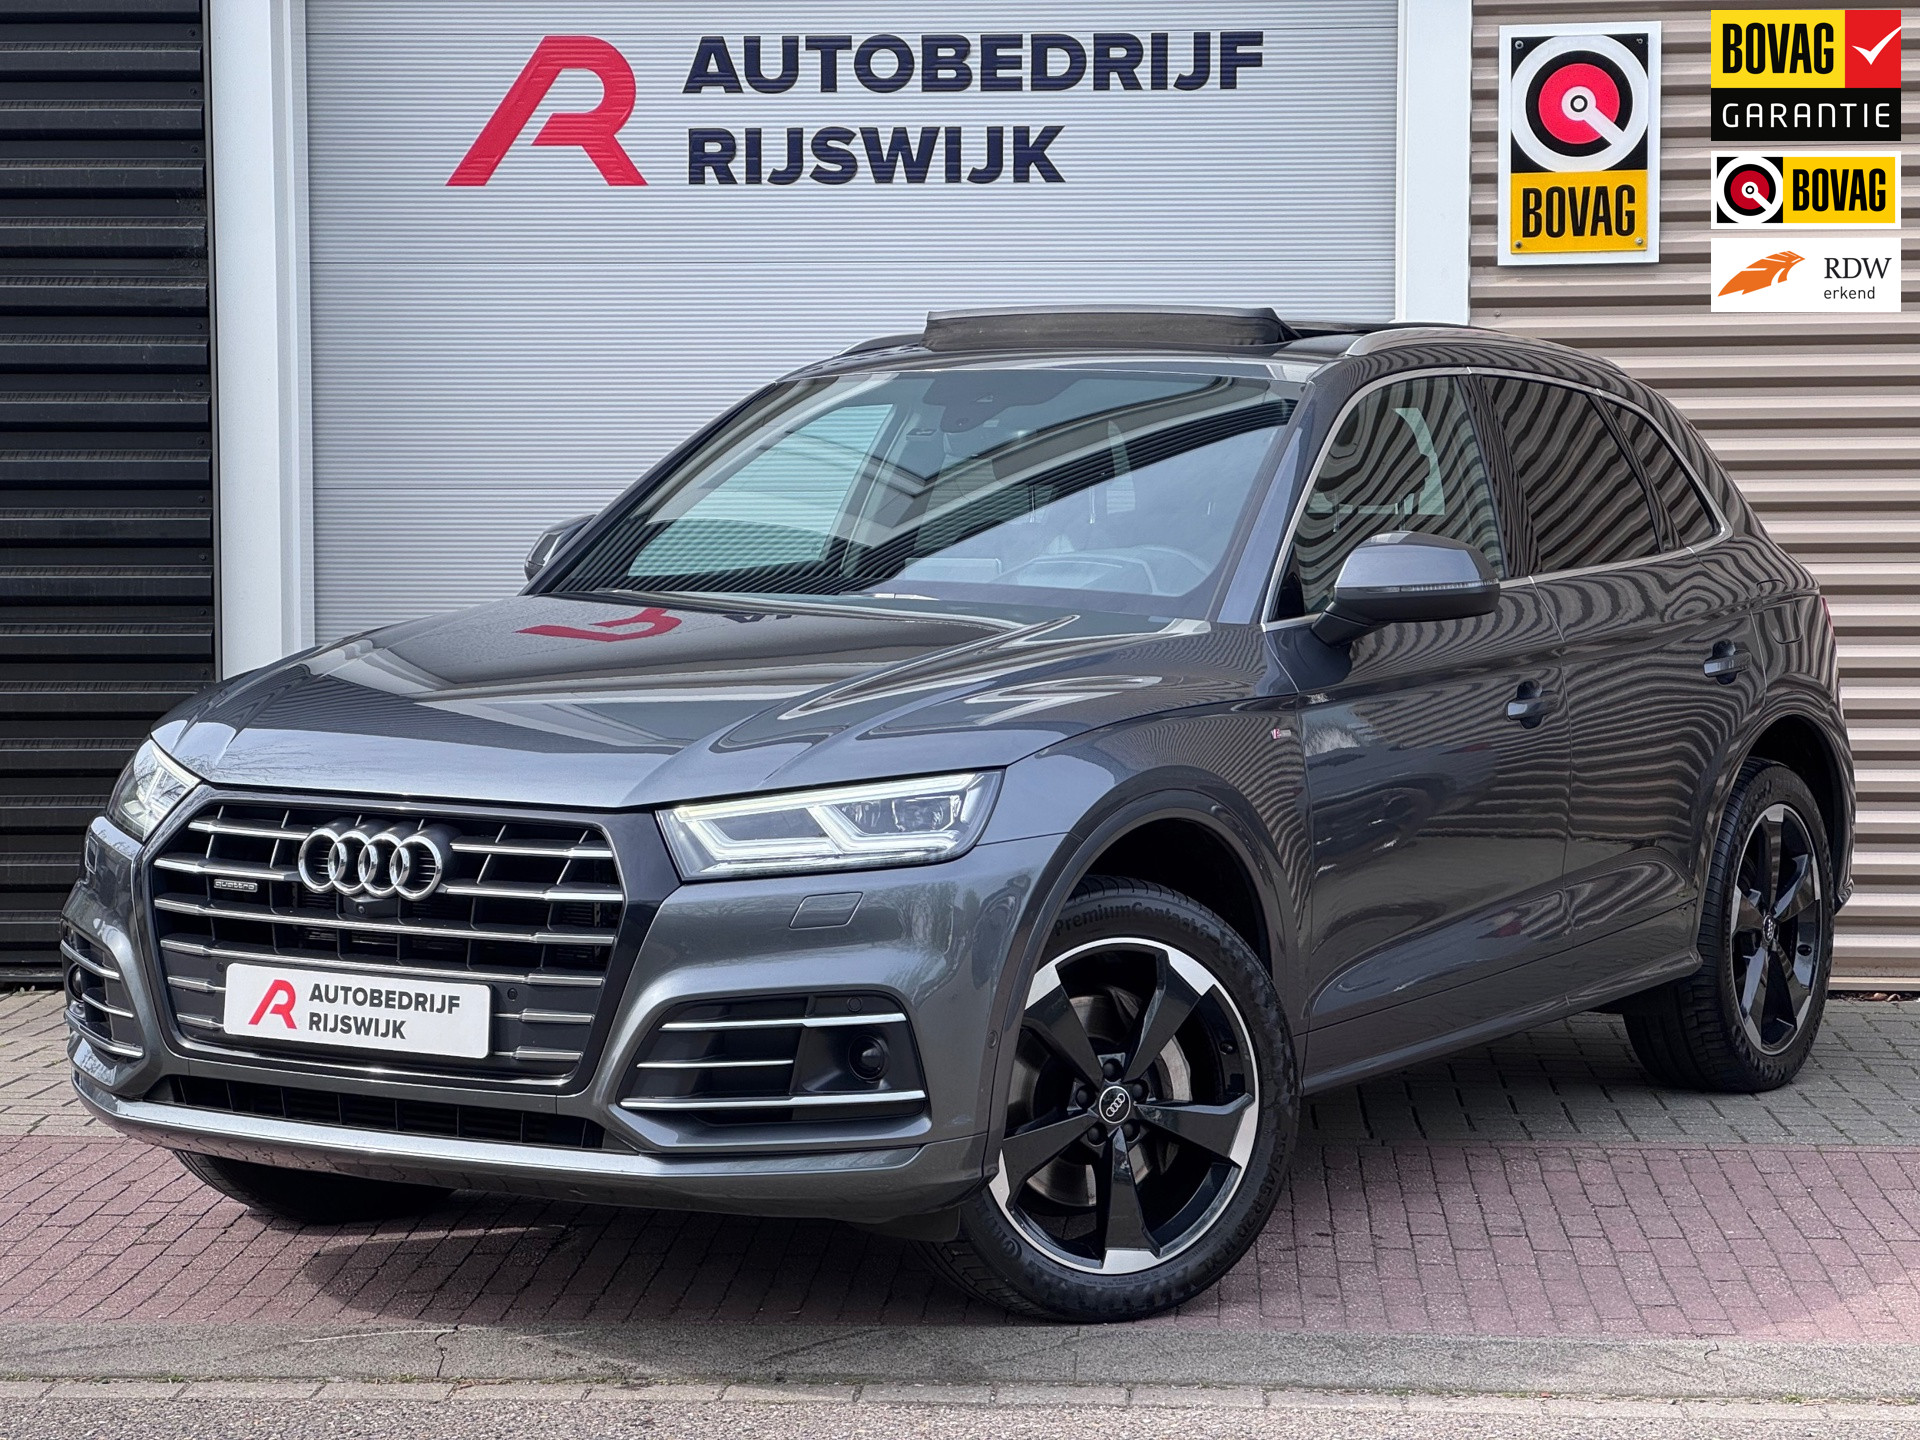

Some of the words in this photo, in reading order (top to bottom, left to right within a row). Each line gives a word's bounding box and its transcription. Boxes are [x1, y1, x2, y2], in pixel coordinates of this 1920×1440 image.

[683, 31, 1264, 94] AUTOBEDRIJF
[688, 125, 1066, 185] RIJSWIJK
[1522, 184, 1636, 238] BOVAG
[308, 983, 461, 1014] AUTOBEDRIJF
[308, 1012, 407, 1040] RIJSWIJK
